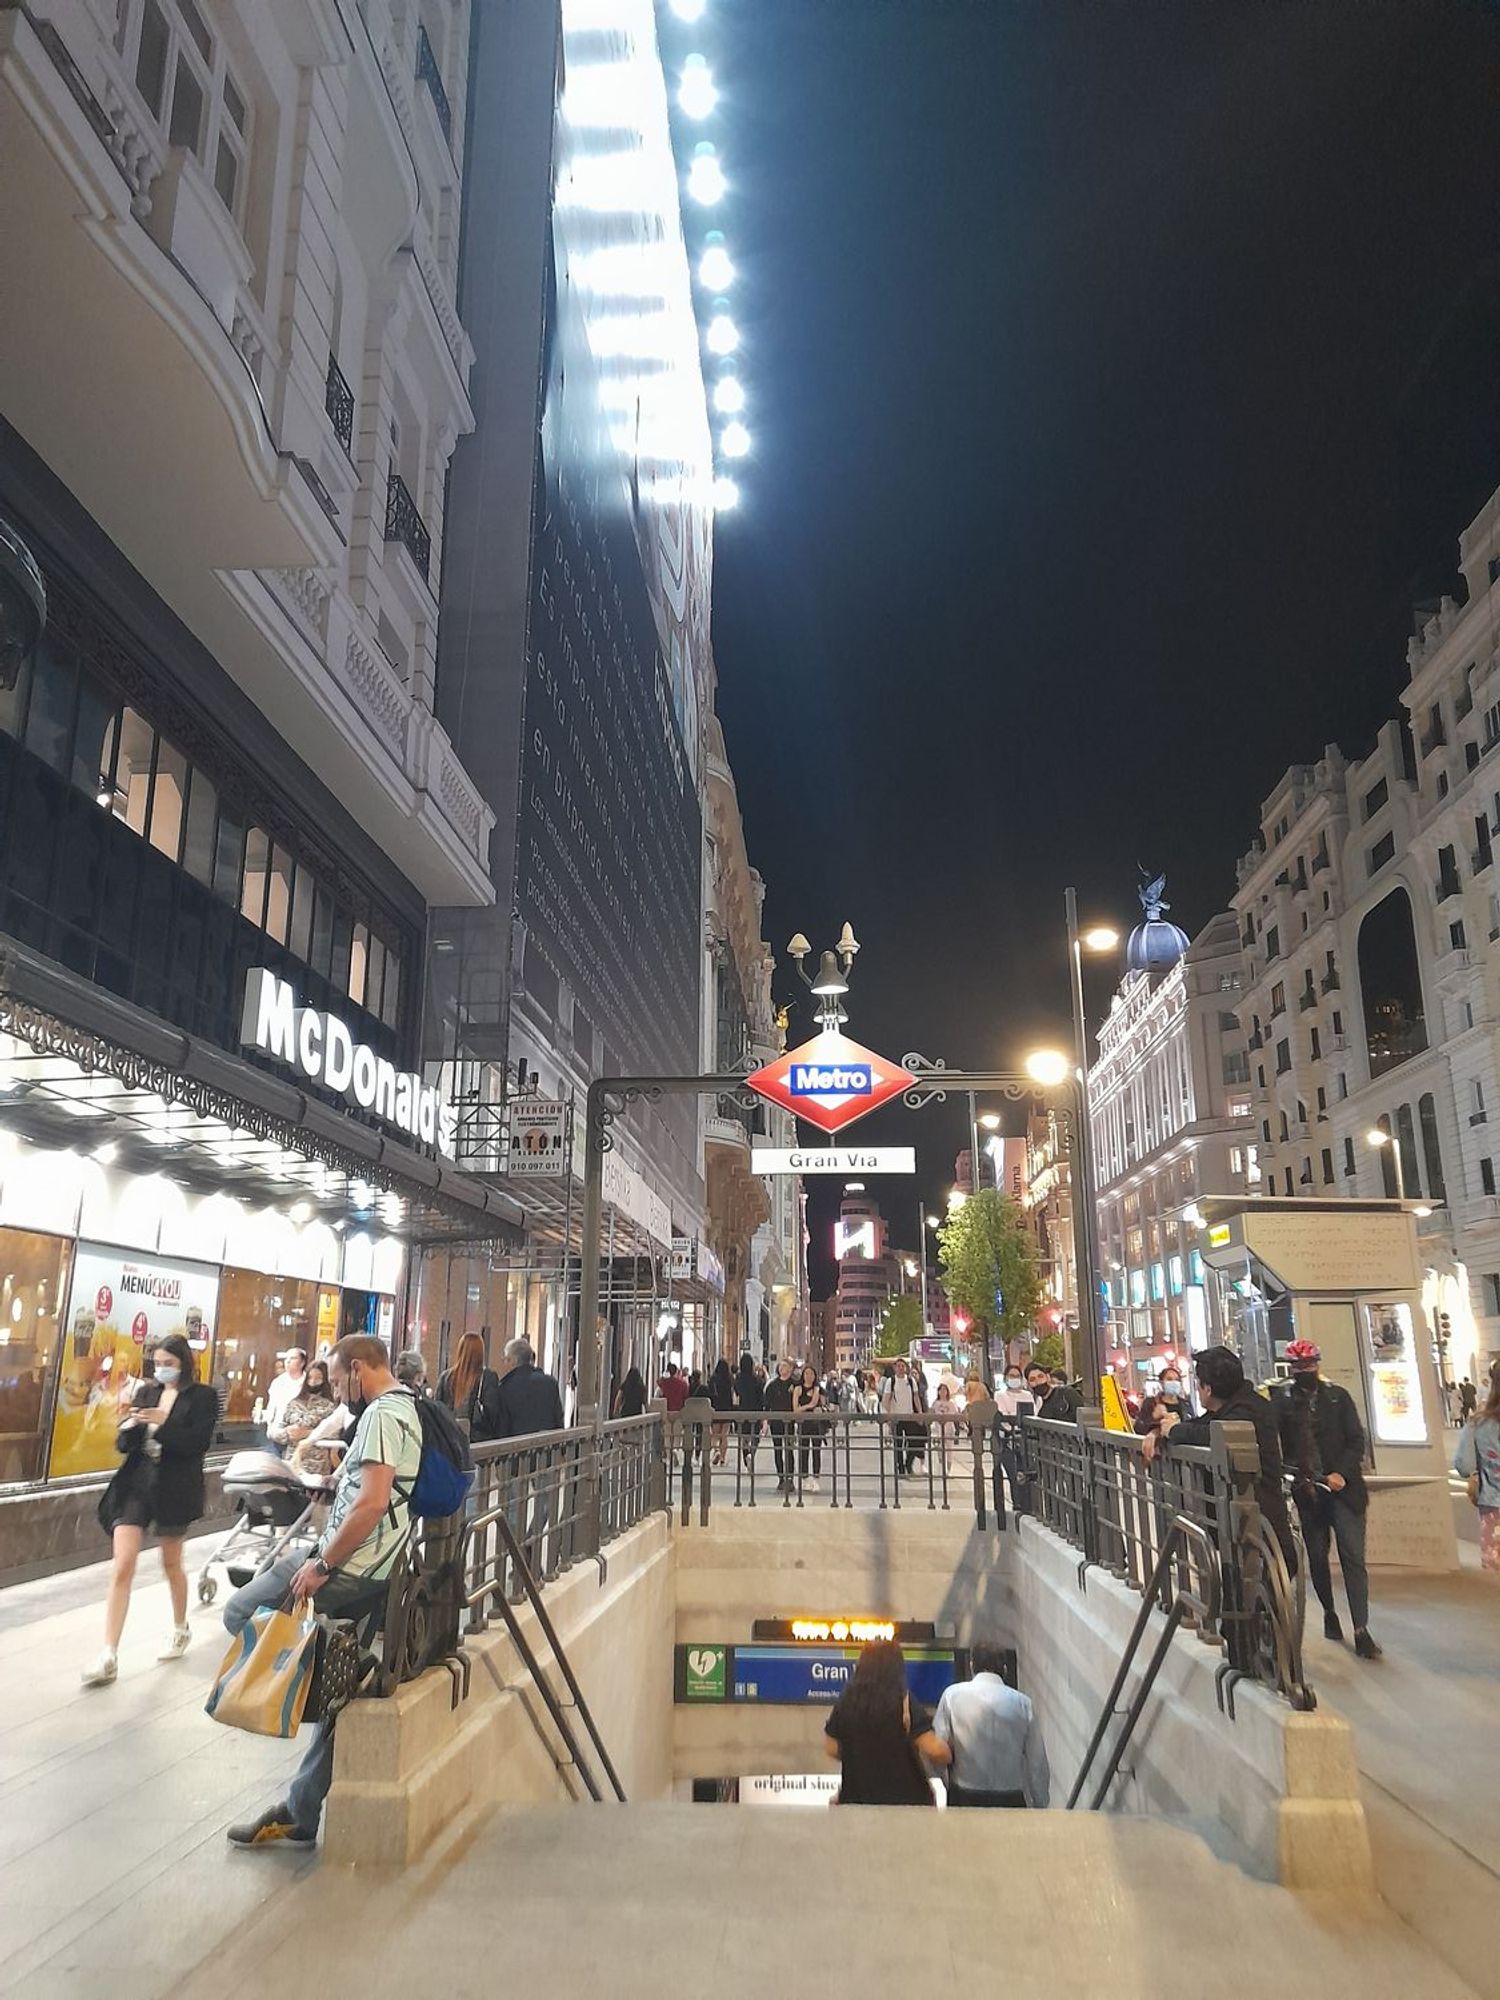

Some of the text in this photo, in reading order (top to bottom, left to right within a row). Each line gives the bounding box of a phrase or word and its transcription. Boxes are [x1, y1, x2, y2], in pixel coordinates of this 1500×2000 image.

[537, 651, 565, 725] esta
[539, 567, 555, 621] Es
[559, 614, 614, 776] importante
[533, 728, 549, 773] en
[240, 967, 457, 1163] McDonald's
[796, 1068, 868, 1090] Metro
[789, 1153, 839, 1168] Gran
[811, 1662, 849, 1680] Gran
[754, 1774, 807, 1793] original
